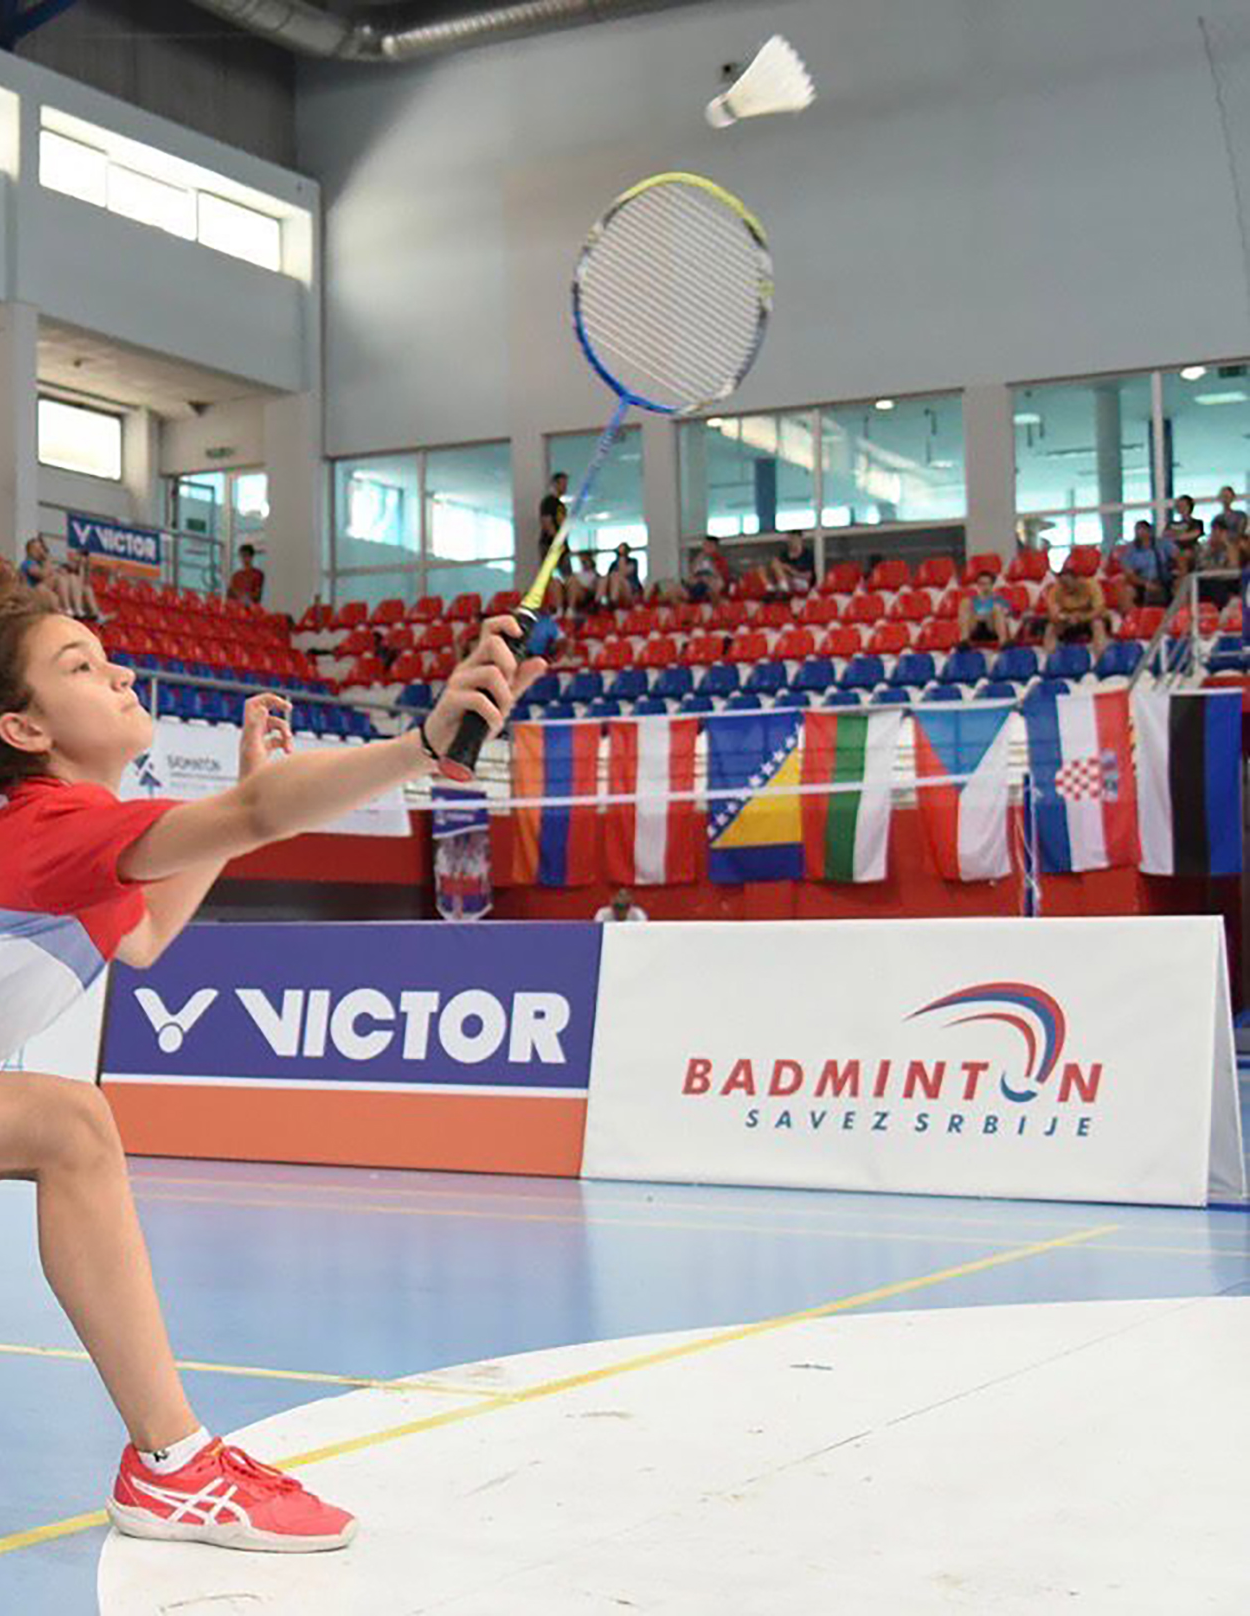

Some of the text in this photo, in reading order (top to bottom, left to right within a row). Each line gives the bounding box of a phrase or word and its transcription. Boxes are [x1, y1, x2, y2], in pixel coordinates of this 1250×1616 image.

[94, 526, 157, 562] VICTOR
[234, 988, 571, 1065] VICTOR
[681, 1057, 1103, 1104] BADMINTON
[744, 1108, 1092, 1137] SAVEZ SRBIJE
